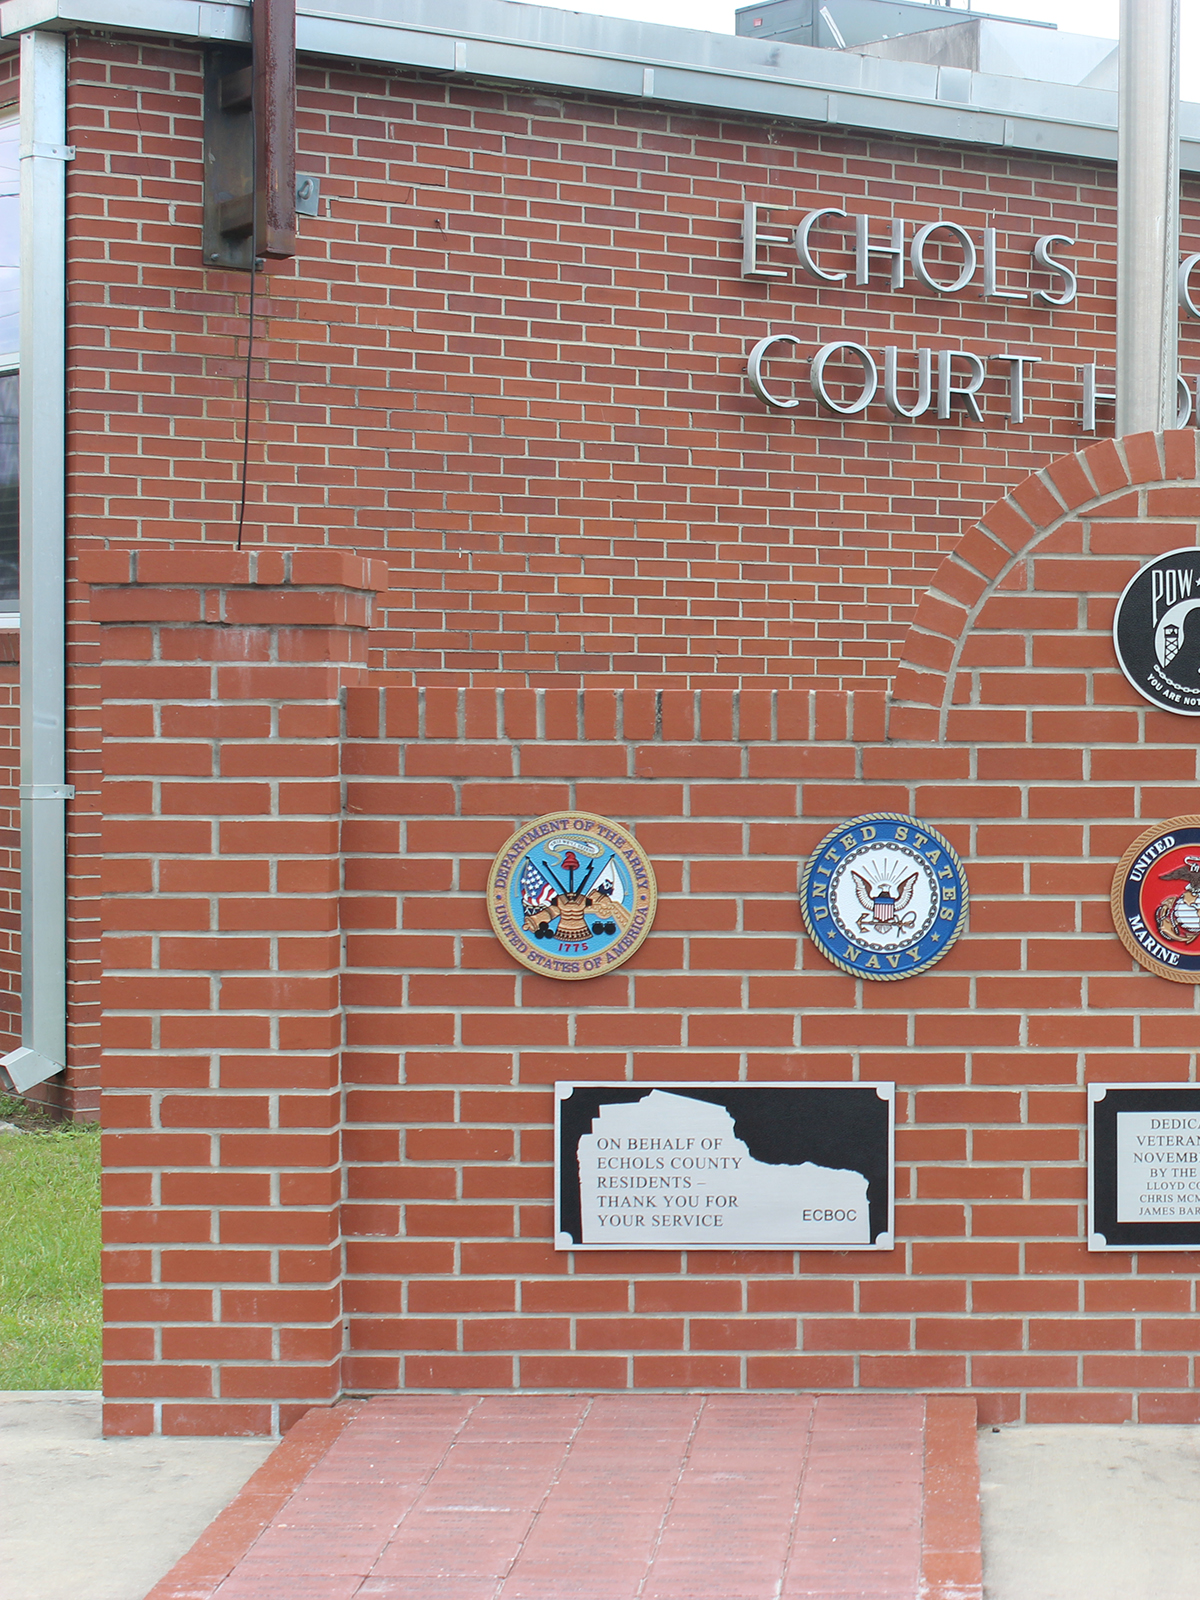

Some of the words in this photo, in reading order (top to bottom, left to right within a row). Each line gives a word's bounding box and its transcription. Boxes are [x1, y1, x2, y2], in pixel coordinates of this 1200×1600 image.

[742, 202, 1077, 306] ECHOLS
[747, 334, 1041, 424] COURT
[1152, 569, 1193, 628] POW
[1146, 673, 1164, 691] YOU
[1163, 689, 1180, 703] ARE
[495, 819, 569, 889] DEPARTMENT
[573, 819, 595, 831] OF
[597, 824, 626, 848] THE
[623, 849, 649, 890] ARMY
[1129, 836, 1176, 882] UNITED
[812, 826, 877, 921] UNITED
[895, 826, 957, 922] STATES
[496, 904, 527, 958] UNITED
[527, 951, 580, 973] STATES
[583, 957, 602, 972] OF
[606, 906, 648, 964] AMERICA
[1128, 914, 1181, 966] MARINE
[558, 942, 589, 952] 1775
[843, 944, 922, 969] NAVY
[597, 1138, 622, 1151] ON
[627, 1138, 695, 1150] BEHALF
[700, 1137, 723, 1150] OF
[597, 1157, 665, 1170] ECHOLS
[670, 1157, 743, 1169] COUNTY
[1149, 1168, 1168, 1178] BY
[1171, 1168, 1197, 1178] THE
[597, 1176, 692, 1189] RESIDENTS
[1146, 1182, 1185, 1190] LLOYD
[596, 1195, 657, 1208] THANK
[663, 1195, 699, 1208] YOU
[705, 1195, 739, 1208] FOR
[1139, 1194, 1173, 1203] CHRIS
[802, 1209, 857, 1222] ECBOC
[1139, 1207, 1175, 1216] JAMES
[597, 1214, 645, 1227] YOUR
[651, 1214, 724, 1227] SERVICE
